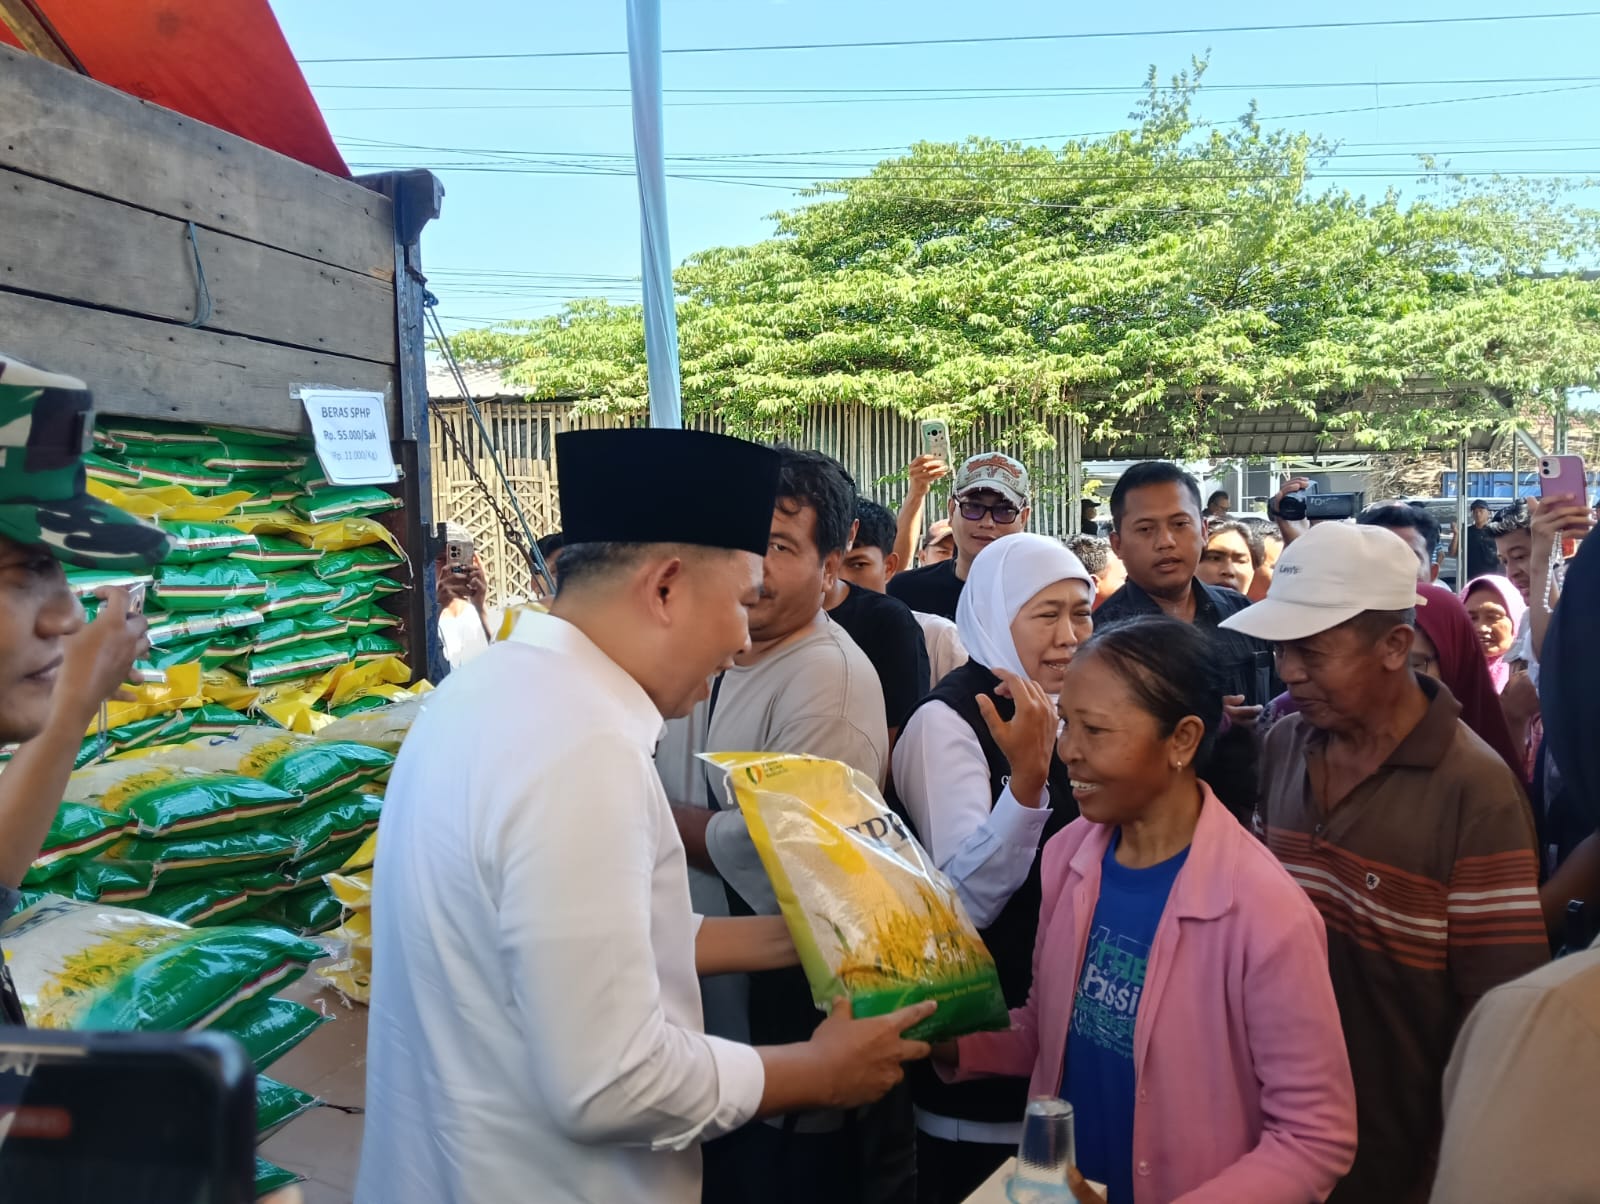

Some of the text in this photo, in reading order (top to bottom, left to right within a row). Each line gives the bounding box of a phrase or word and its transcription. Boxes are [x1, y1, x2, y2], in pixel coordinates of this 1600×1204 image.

[321, 406, 371, 419] BERAS SPHP
[323, 429, 377, 442] Rp. 55.000/Sak
